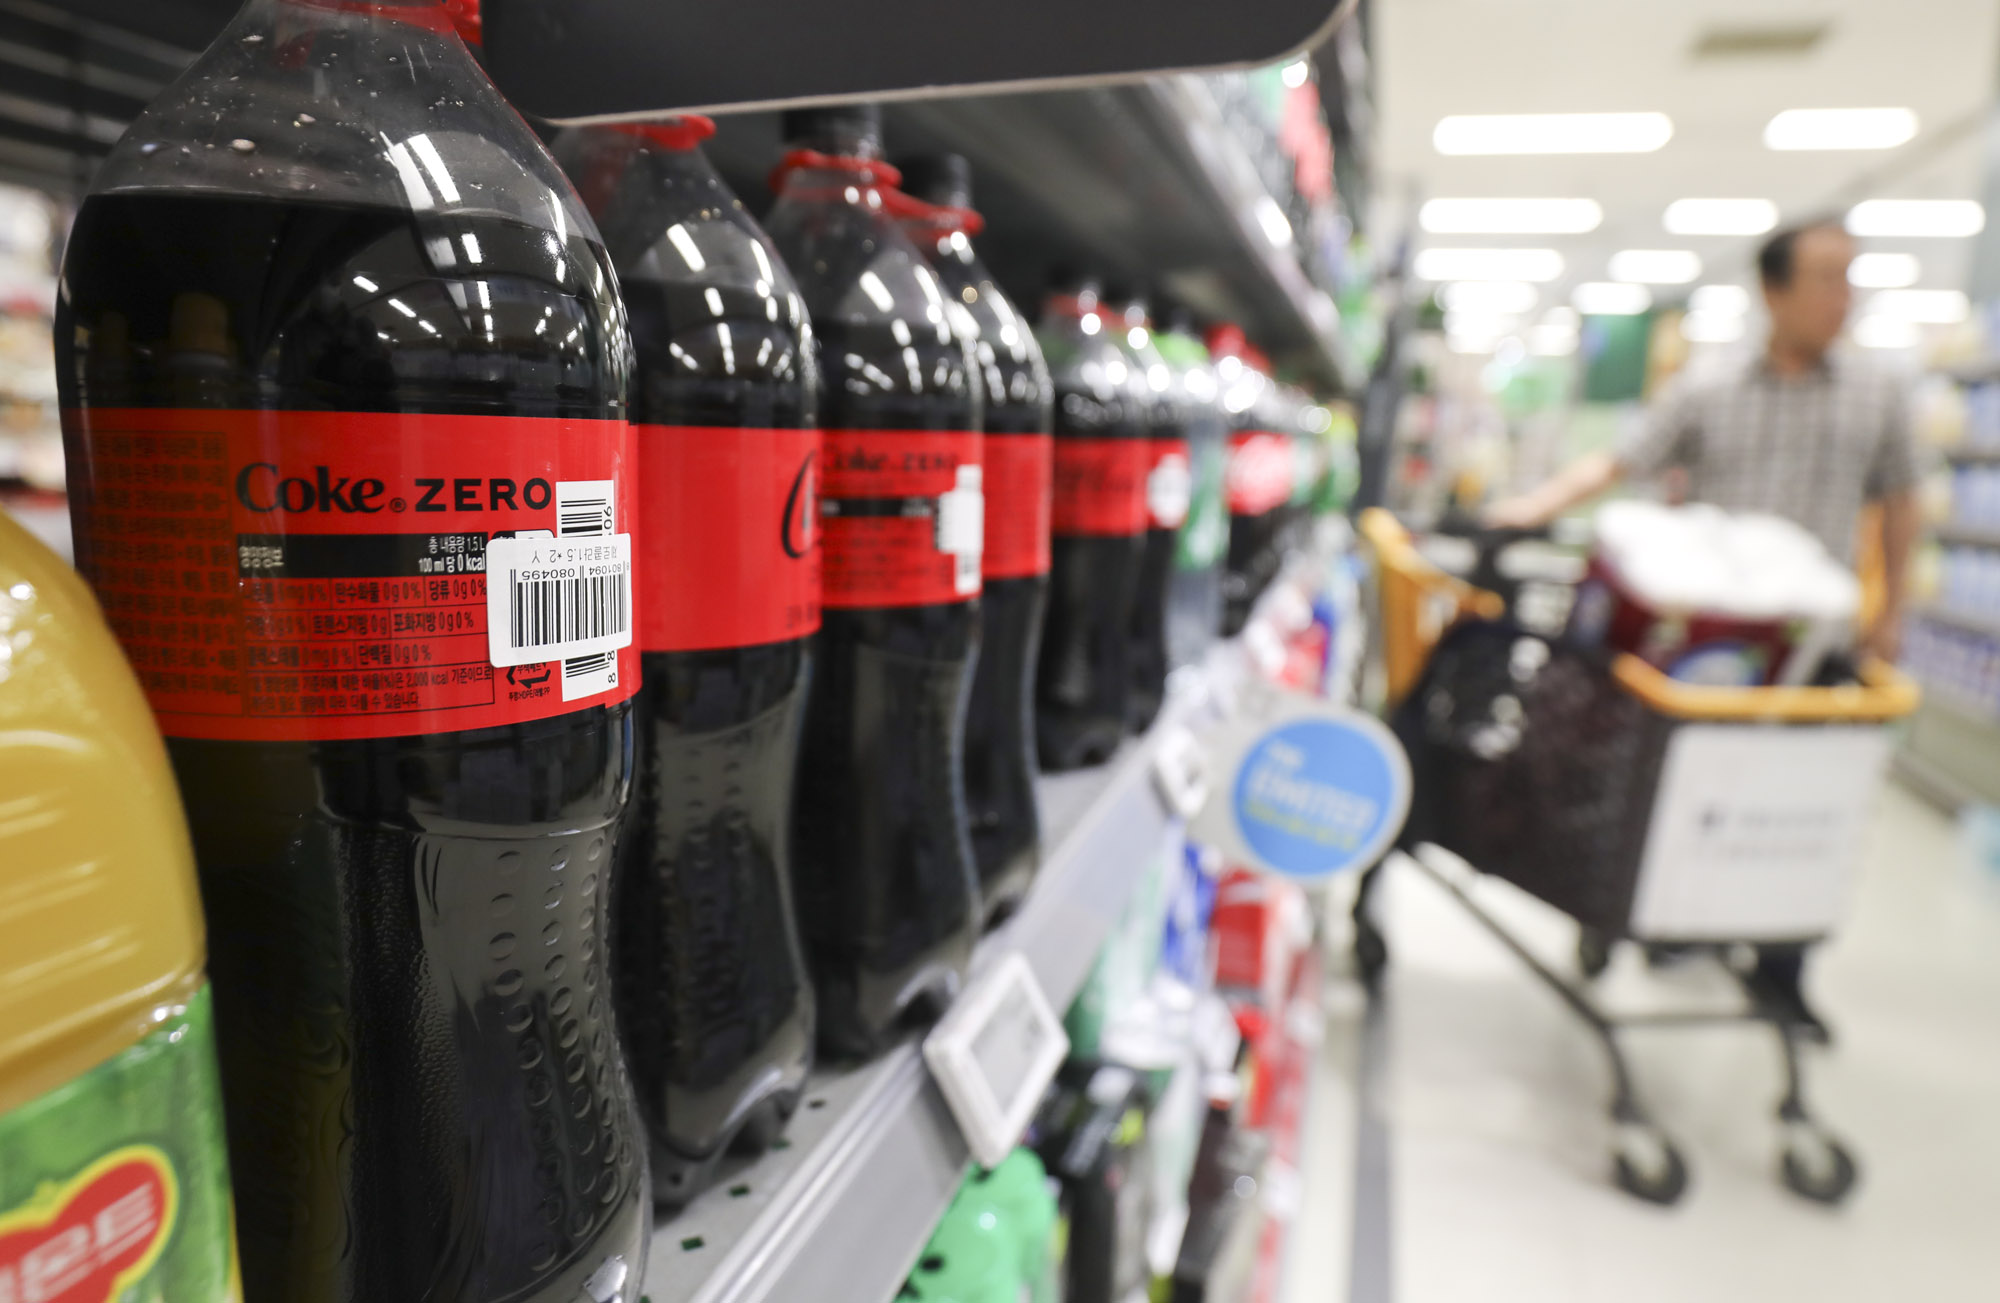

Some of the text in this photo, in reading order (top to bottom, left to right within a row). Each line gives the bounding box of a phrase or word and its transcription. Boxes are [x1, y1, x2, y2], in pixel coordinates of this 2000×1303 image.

[236, 462, 384, 513] Coke
[414, 477, 552, 512] ZERO
[446, 556, 455, 573] 당
[465, 553, 485, 571] kcal
[532, 550, 540, 563] Y
[522, 568, 575, 580] 080495
[589, 564, 621, 576] 801094
[429, 580, 449, 601] 당류
